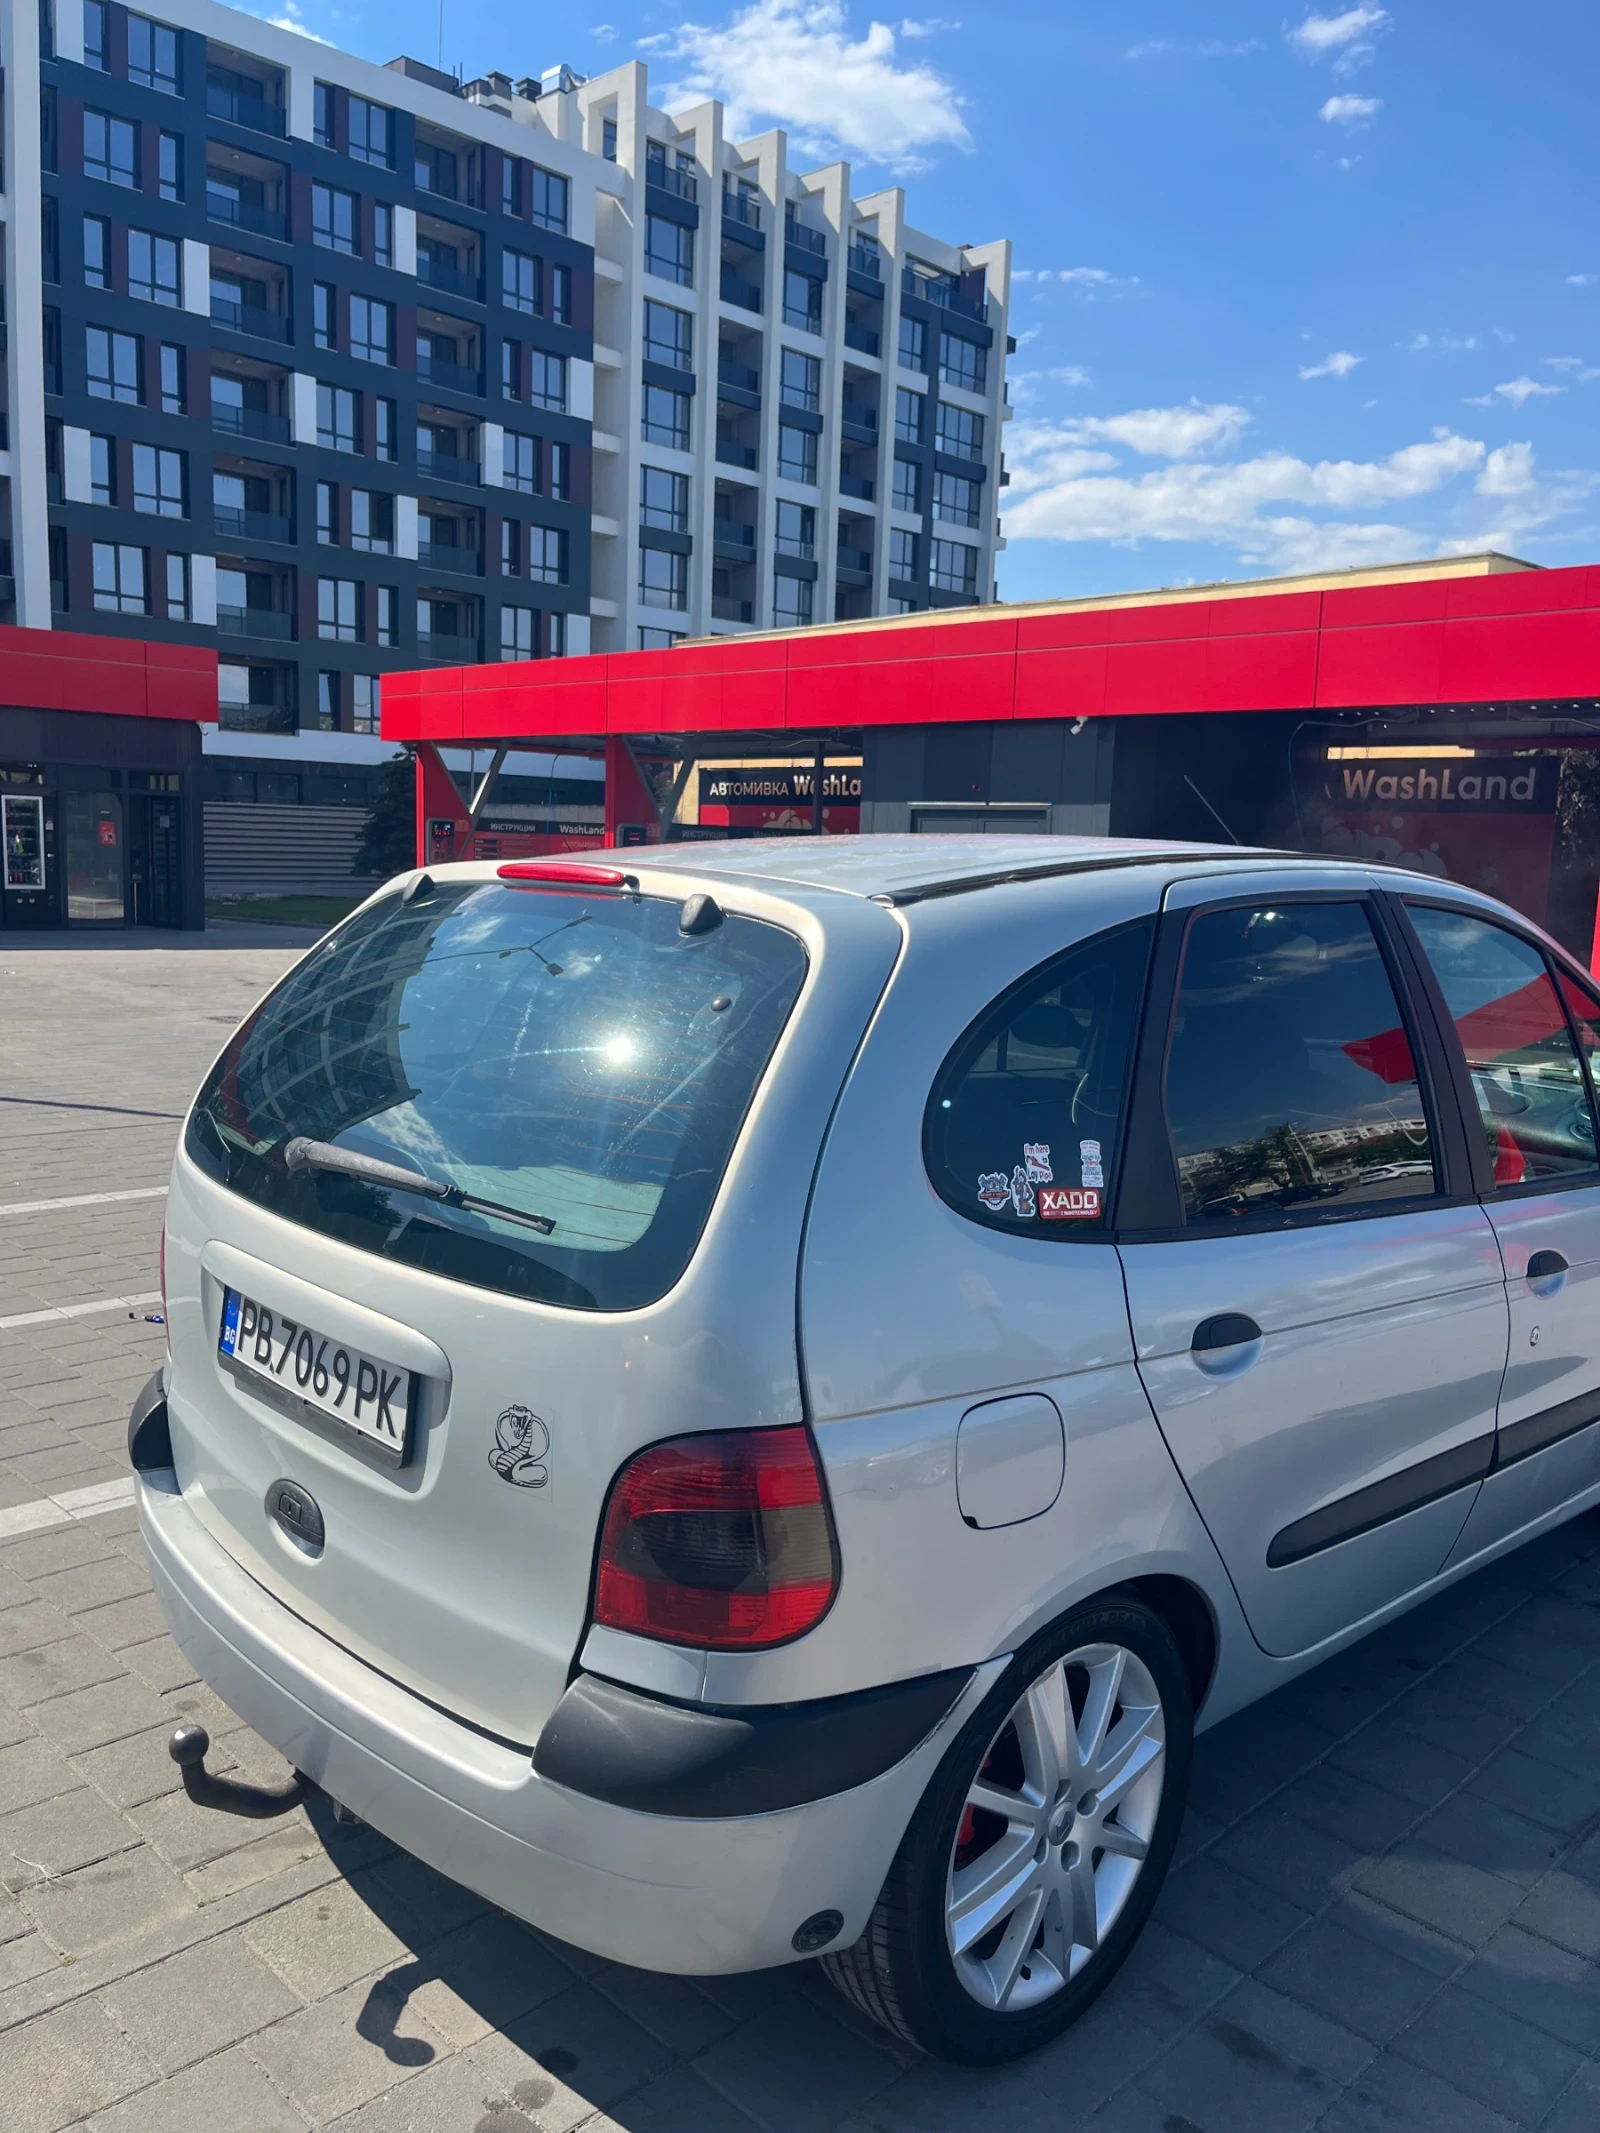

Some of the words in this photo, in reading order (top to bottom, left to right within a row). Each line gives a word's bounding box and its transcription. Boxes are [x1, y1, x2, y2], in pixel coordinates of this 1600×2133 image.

[709, 782, 789, 796] АВТОМИВКА
[1343, 768, 1536, 800] WashLand
[490, 823, 536, 833] ИНСТРУКЦИИ
[559, 824, 605, 835] WashLand
[1042, 1191, 1097, 1209] XADO
[224, 1326, 236, 1344] BG
